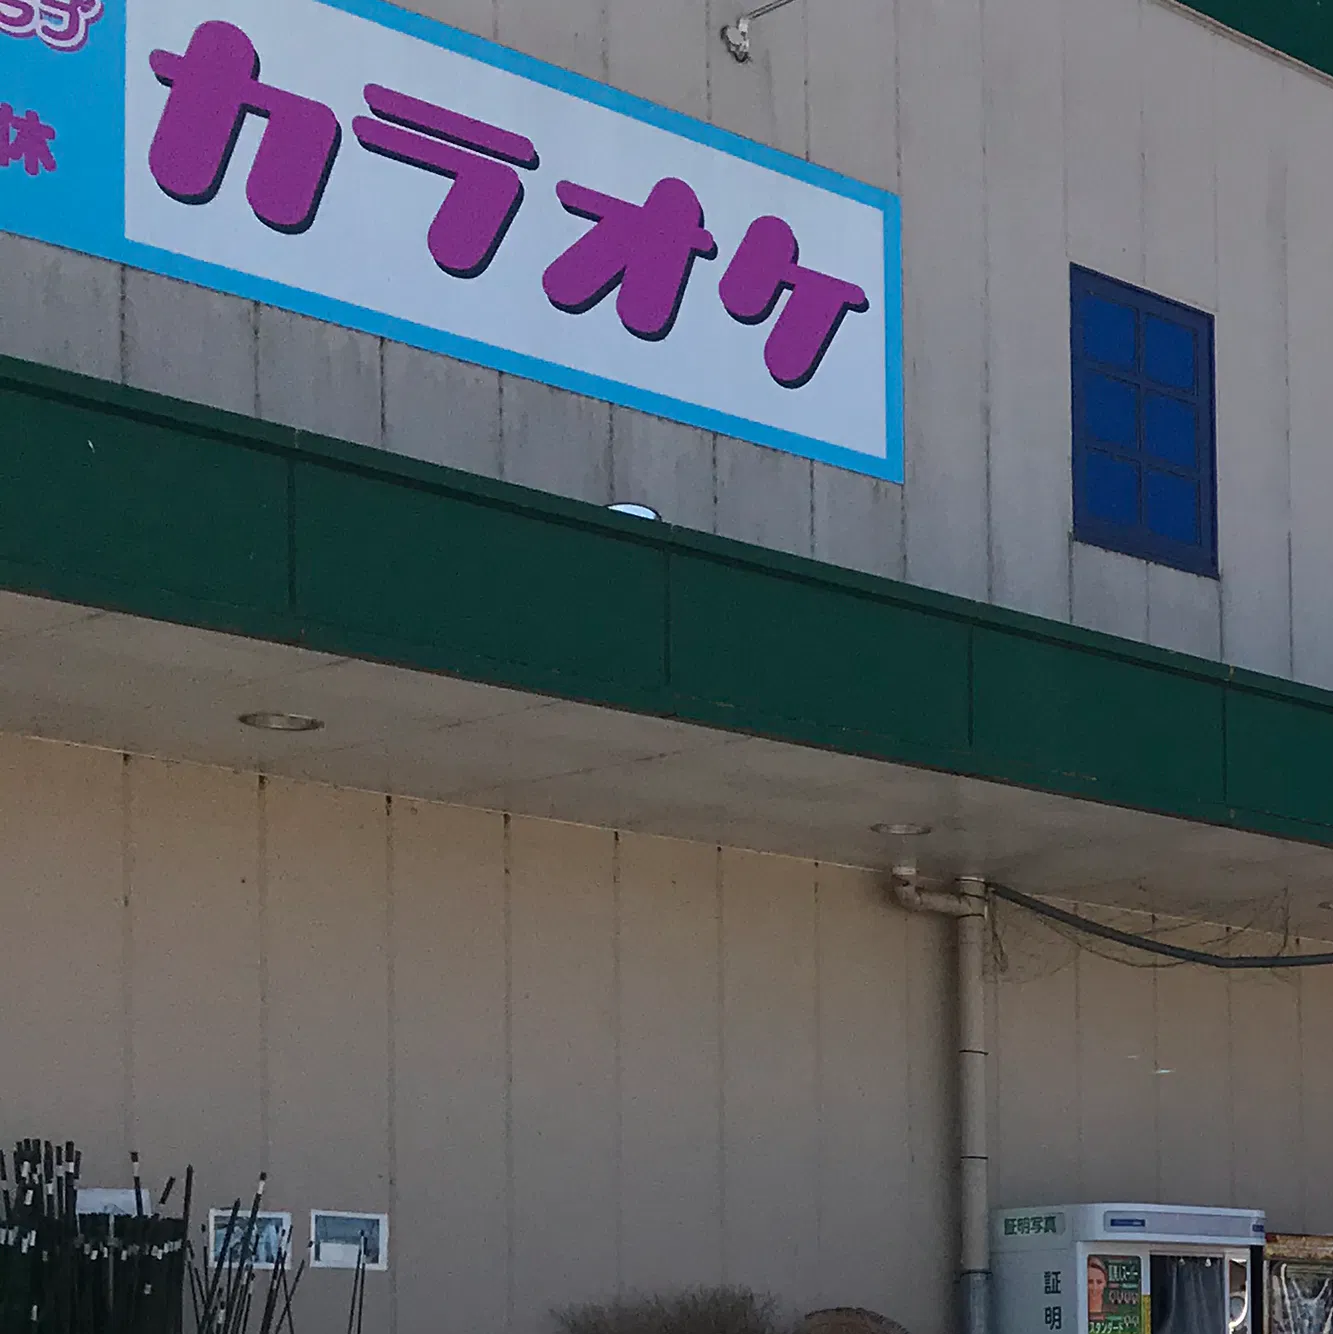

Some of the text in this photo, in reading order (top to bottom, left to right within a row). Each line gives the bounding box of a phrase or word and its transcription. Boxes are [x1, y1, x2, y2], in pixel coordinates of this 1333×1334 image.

[148, 20, 870, 391] カラオケ
[1004, 1216, 1058, 1235] 証明写真
